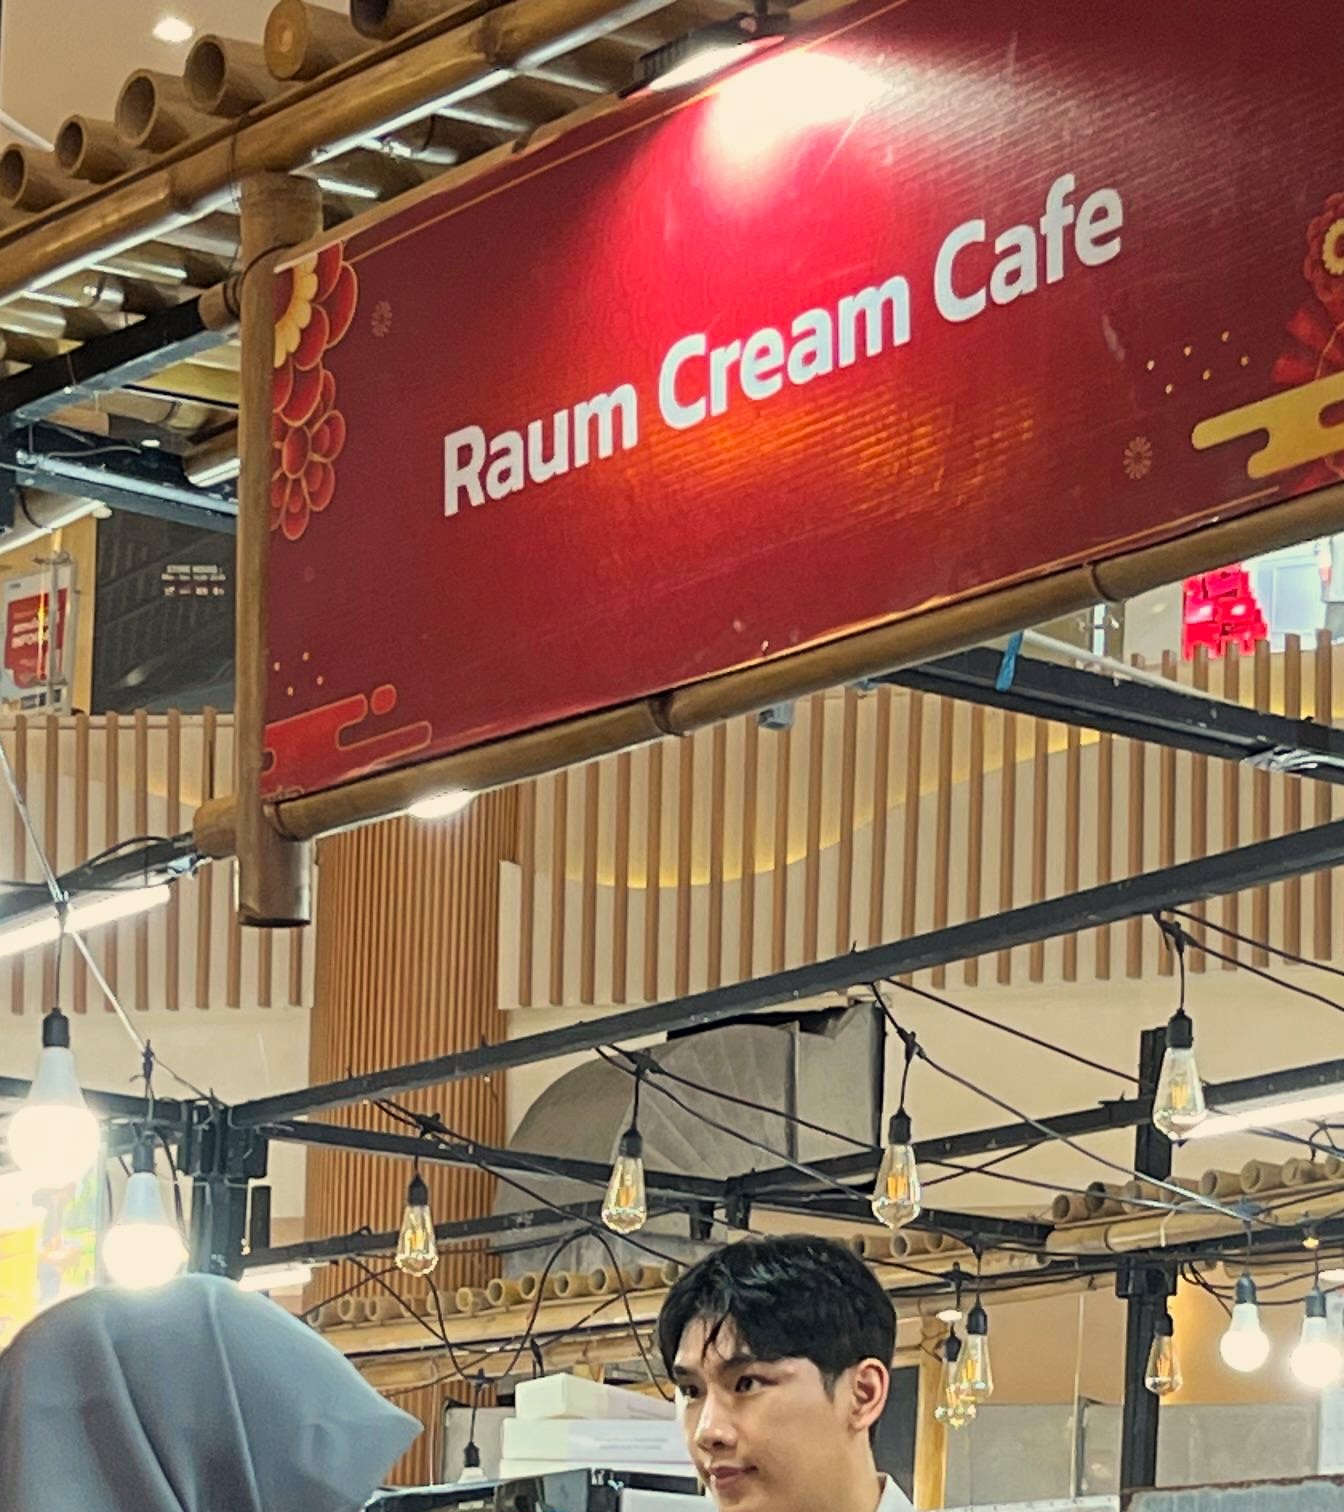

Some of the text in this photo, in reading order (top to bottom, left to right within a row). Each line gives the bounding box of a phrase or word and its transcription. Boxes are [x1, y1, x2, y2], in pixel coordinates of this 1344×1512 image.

[443, 173, 1124, 517] Raum Cream Cafe
